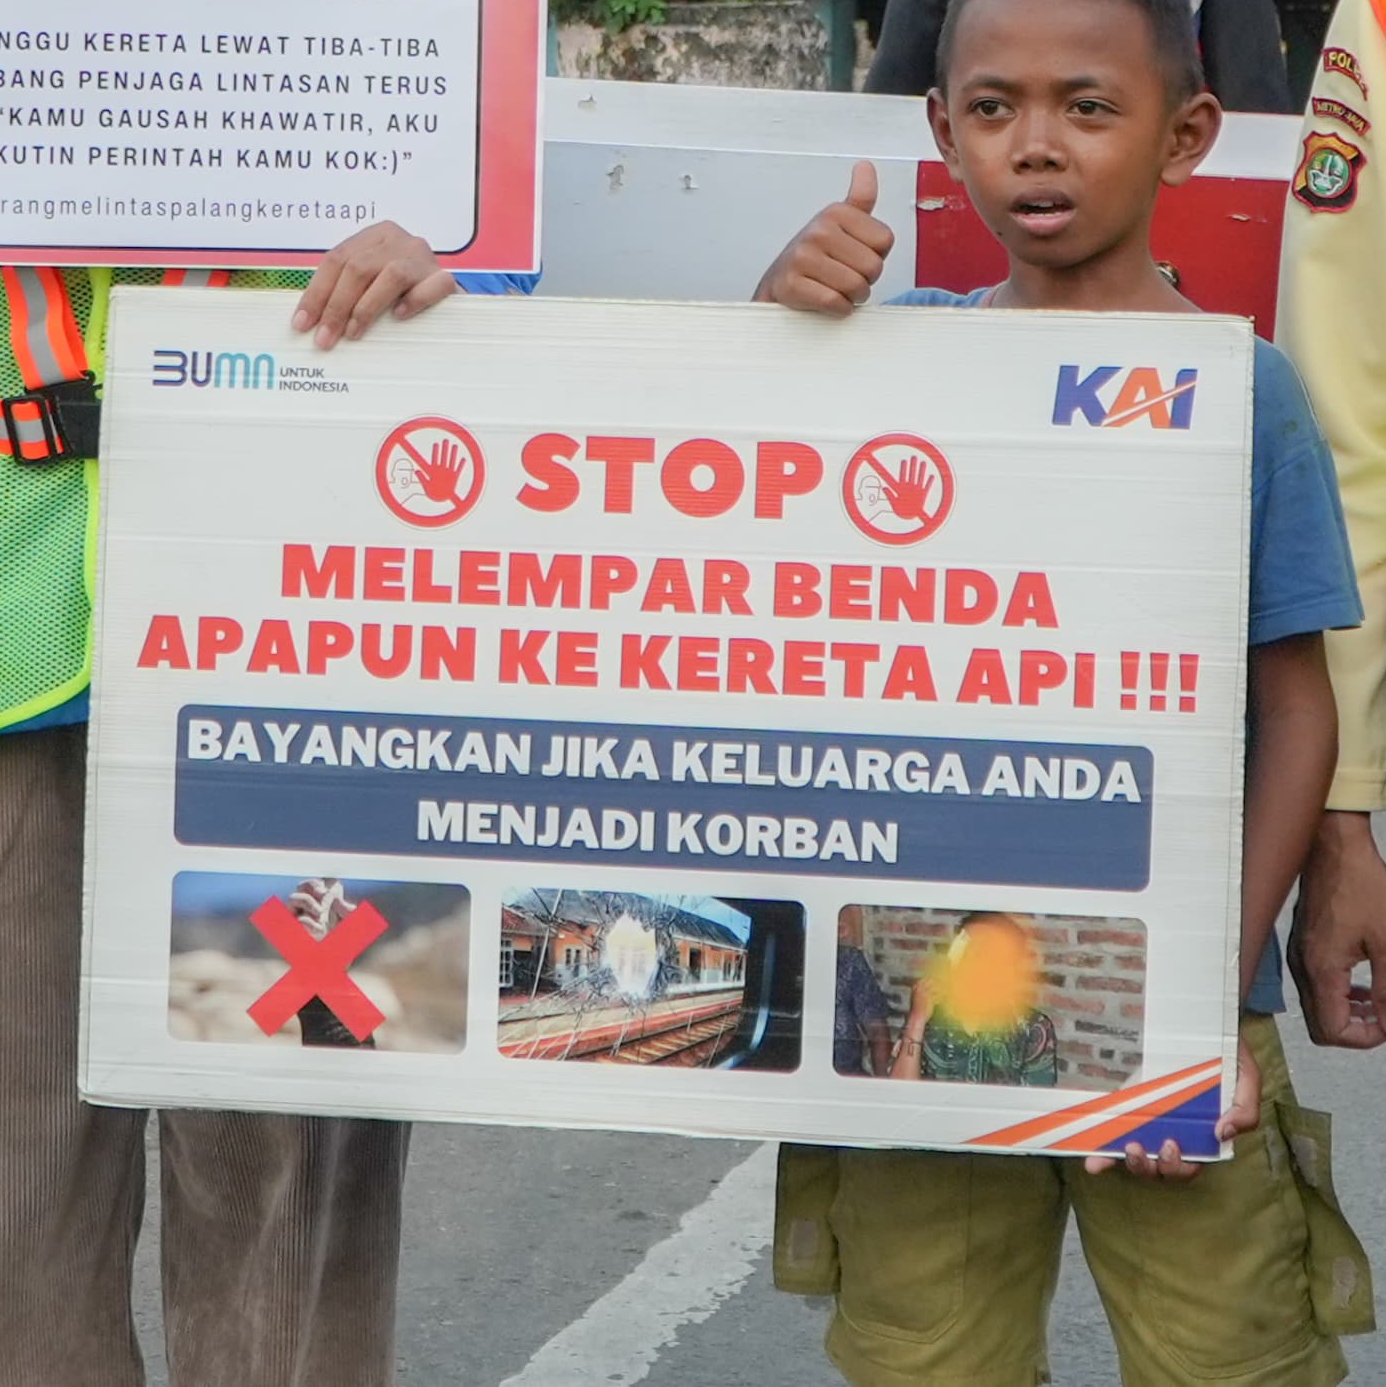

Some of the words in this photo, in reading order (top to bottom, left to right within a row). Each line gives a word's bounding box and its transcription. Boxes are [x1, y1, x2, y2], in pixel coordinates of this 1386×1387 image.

[84, 33, 188, 53] KERETA
[201, 34, 290, 55] LEWAT
[305, 36, 440, 58] TIBA-TIBA
[79, 70, 204, 92] PENJAGA
[217, 72, 350, 94] LINTASAN
[364, 74, 448, 95] TERUS
[98, 108, 209, 129] GAUSAH
[222, 110, 374, 135] KHAWATIR,
[386, 112, 439, 134] AKU
[88, 146, 225, 168] PERINTAH
[237, 148, 312, 170] KAMU
[279, 381, 350, 393] INDONESIA
[280, 367, 325, 378] UNTUK
[1052, 364, 1198, 430] KAI
[516, 432, 824, 520] STOP
[281, 543, 755, 616] MELEMPAR
[773, 562, 1058, 629] BENDA
[137, 615, 476, 681] APAPUN
[498, 629, 598, 688] KE
[620, 634, 937, 702] KERETA
[956, 648, 1096, 709] API
[1120, 651, 1199, 713] !!!
[188, 719, 531, 777] BAYANGKAN
[542, 735, 660, 781] JIKA
[671, 741, 971, 796] KELUARGA
[983, 756, 1142, 803] ANDA
[417, 800, 653, 852] MENJADI
[667, 812, 898, 864] KORBAN
